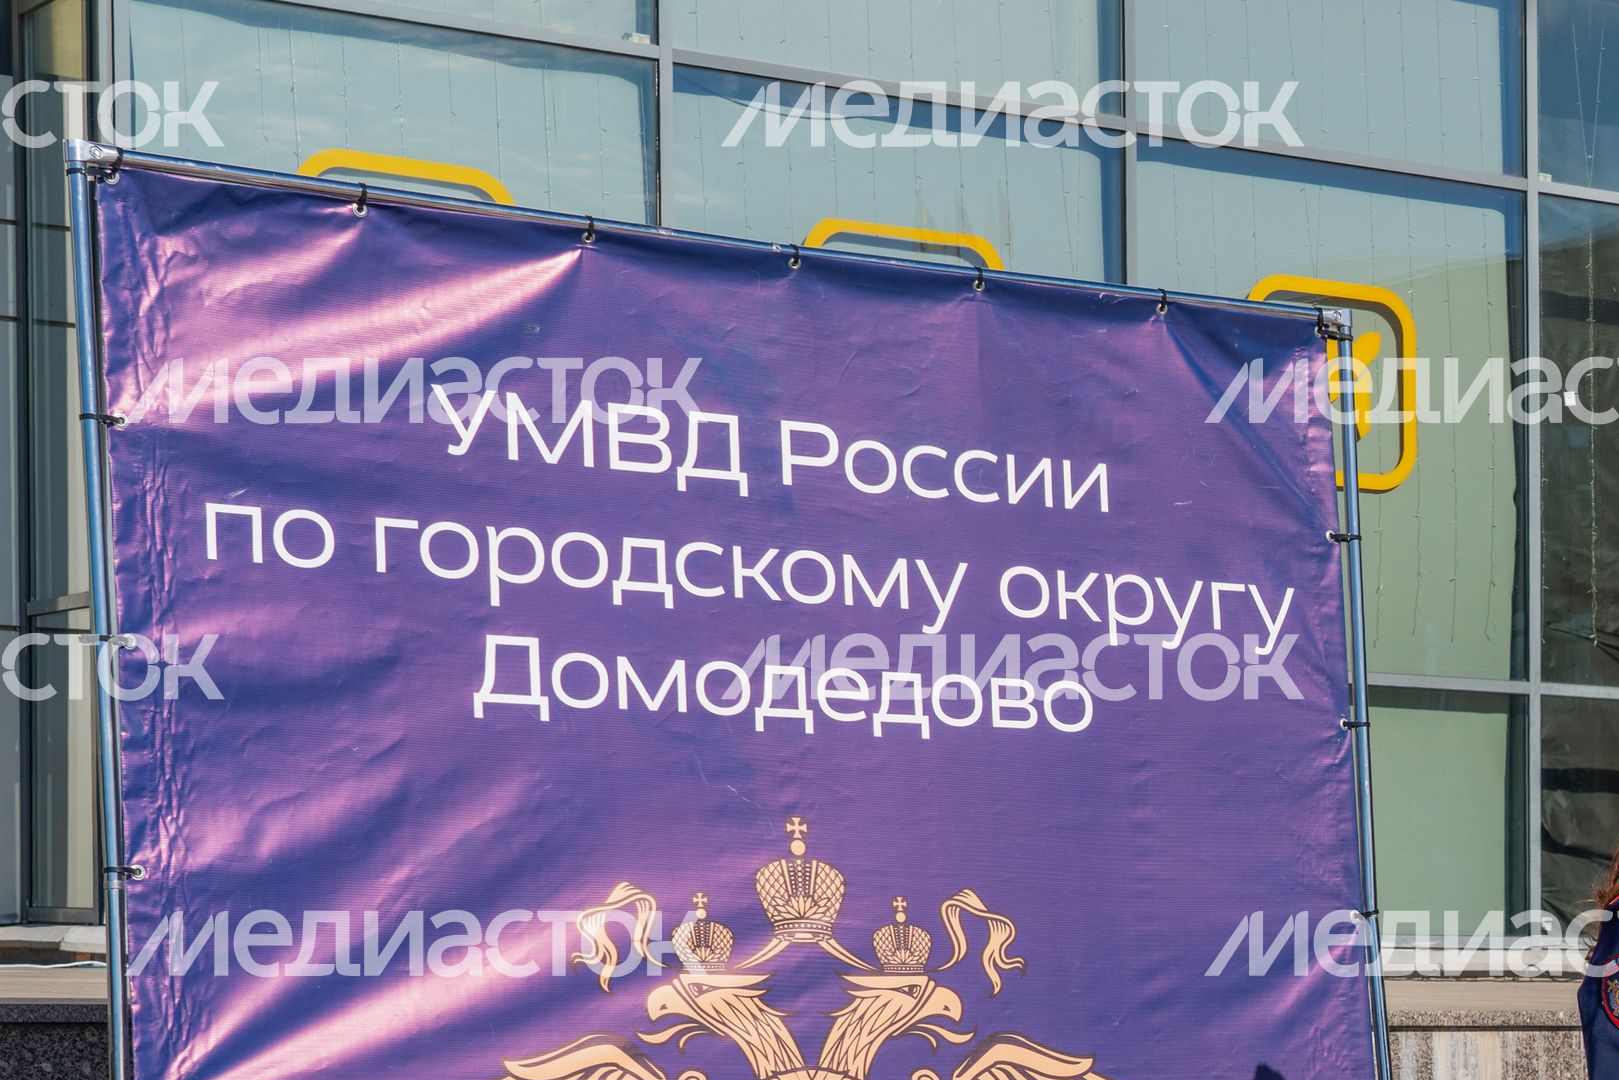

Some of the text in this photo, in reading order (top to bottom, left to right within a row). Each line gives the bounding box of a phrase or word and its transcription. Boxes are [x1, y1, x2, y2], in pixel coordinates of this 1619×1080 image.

[430, 383, 1112, 513] УМВД России
[204, 502, 1296, 656] по городскому округу
[472, 633, 1095, 739] Домодедово
